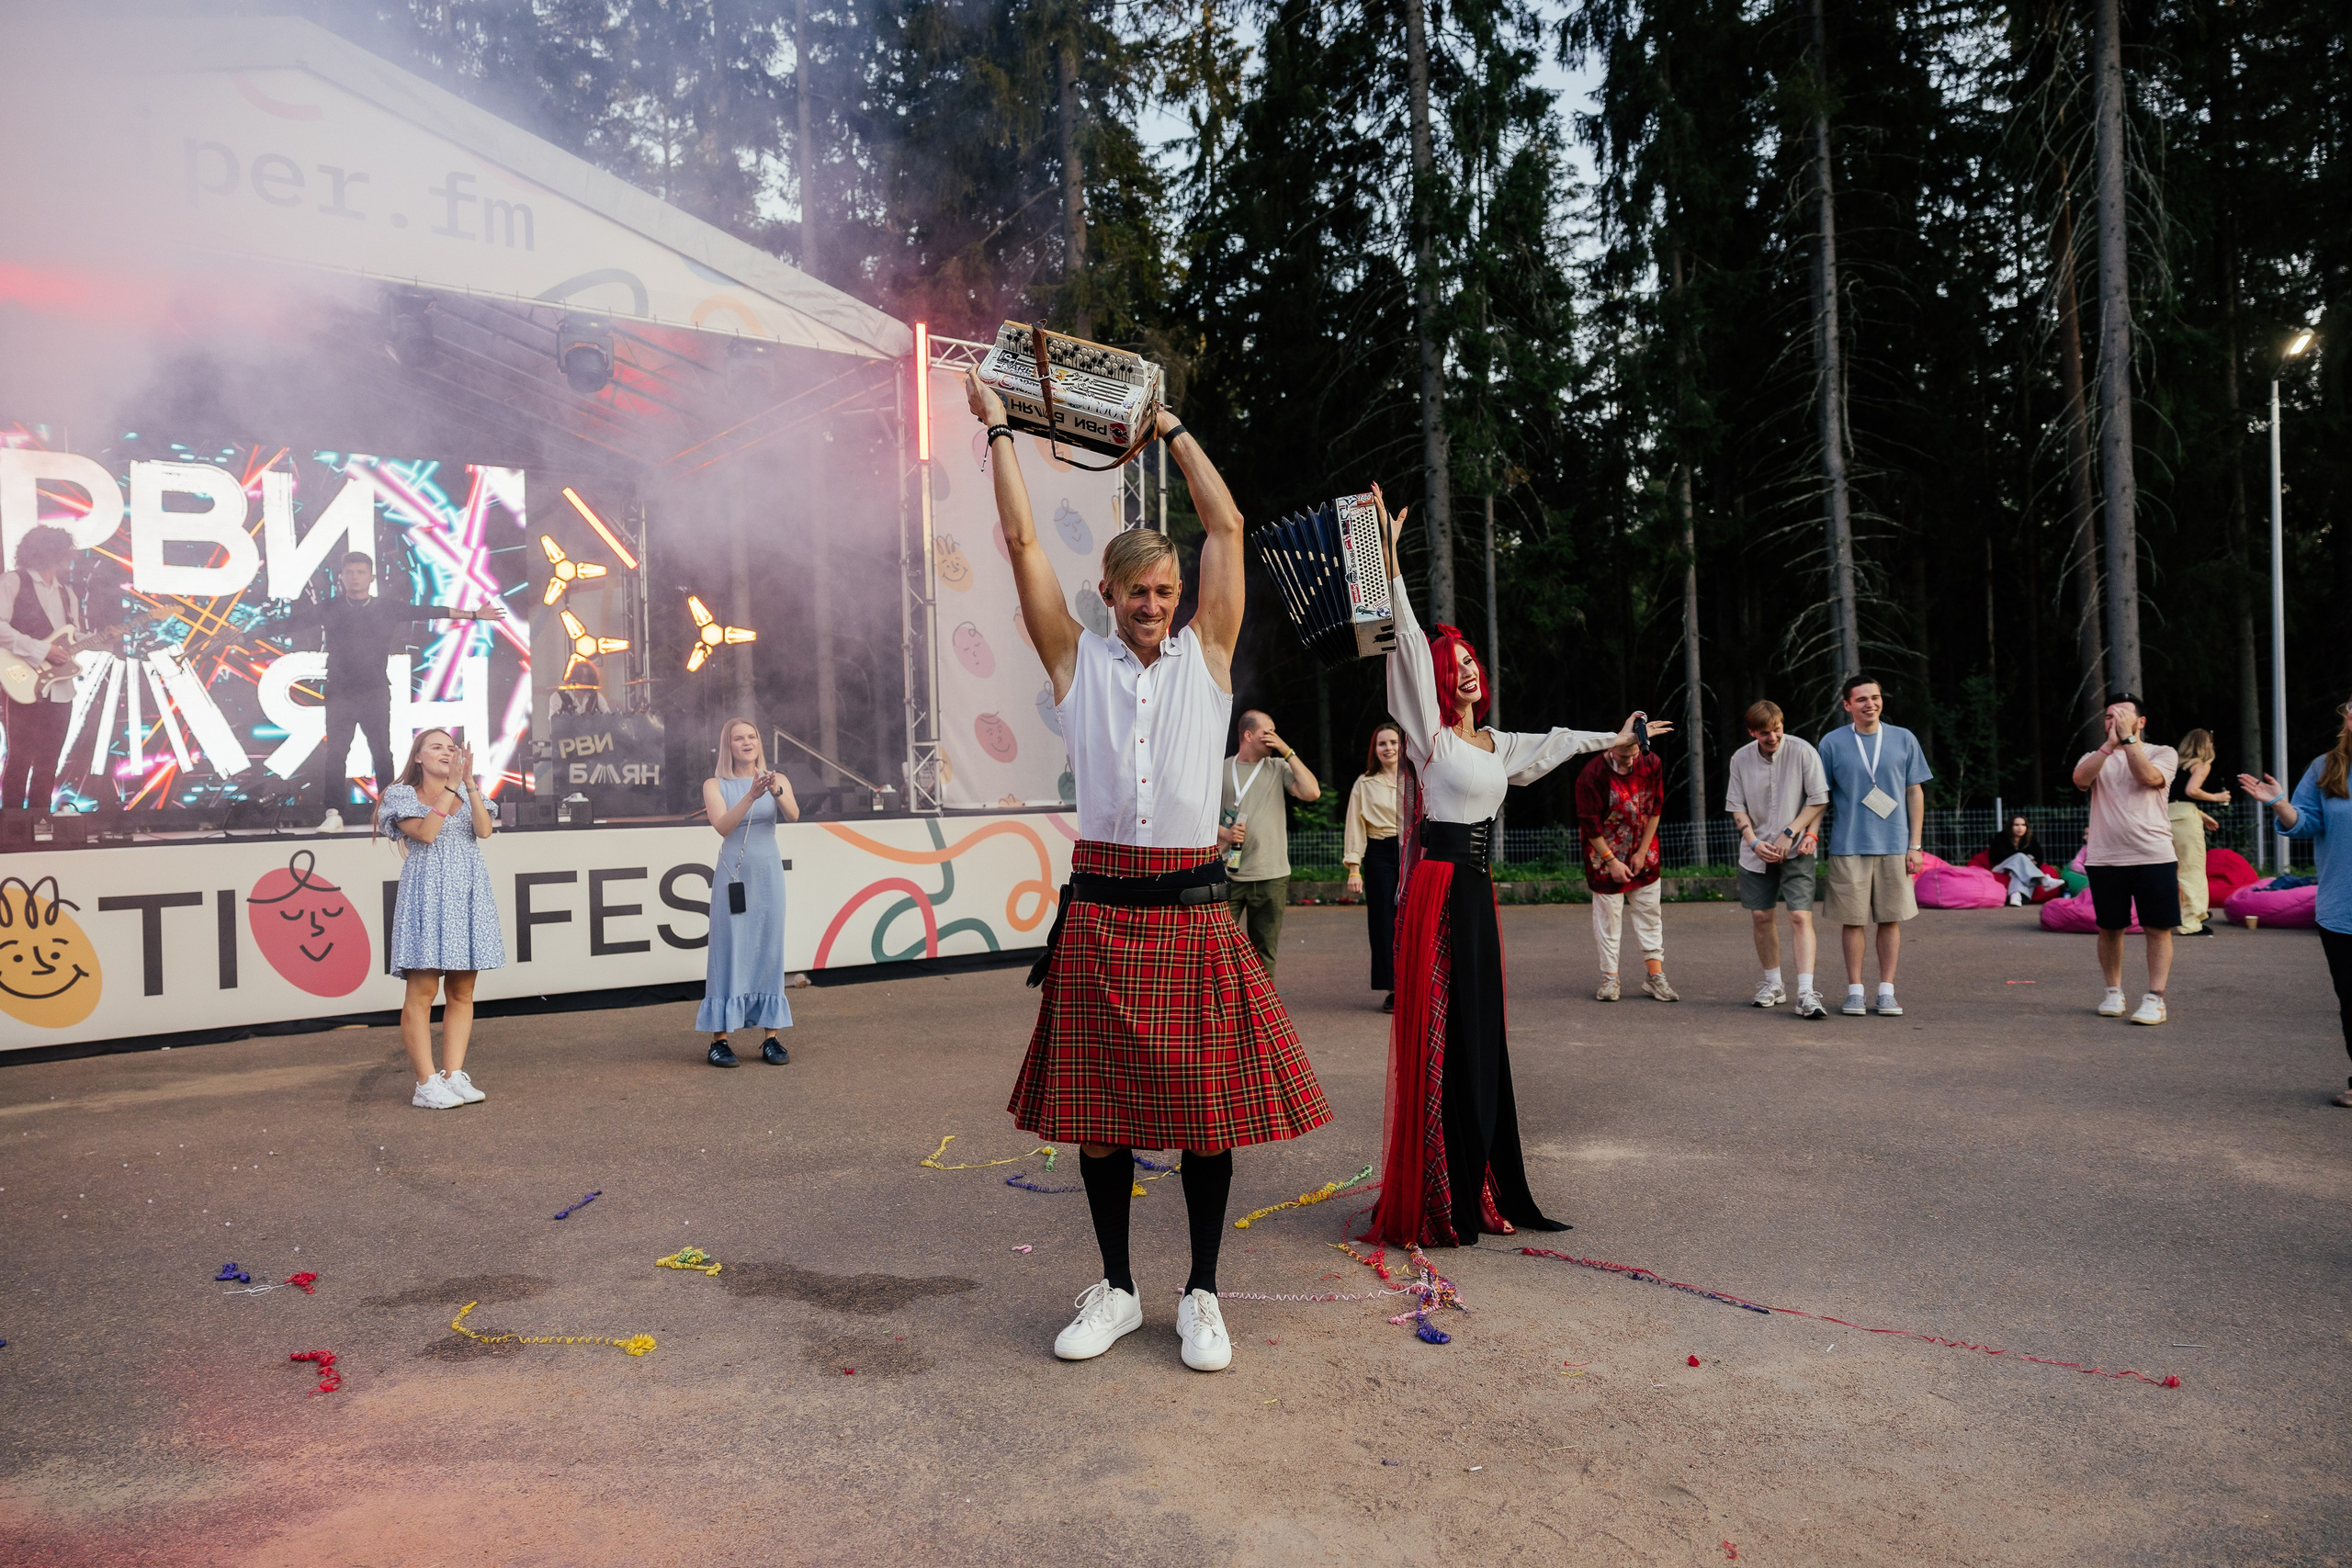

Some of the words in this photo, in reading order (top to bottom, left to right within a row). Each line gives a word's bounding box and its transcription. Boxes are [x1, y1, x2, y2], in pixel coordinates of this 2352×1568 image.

[1074, 416, 1108, 435] РВИ
[0, 447, 379, 602] РВИ
[558, 732, 615, 760] РВИ
[514, 859, 793, 964] FES
